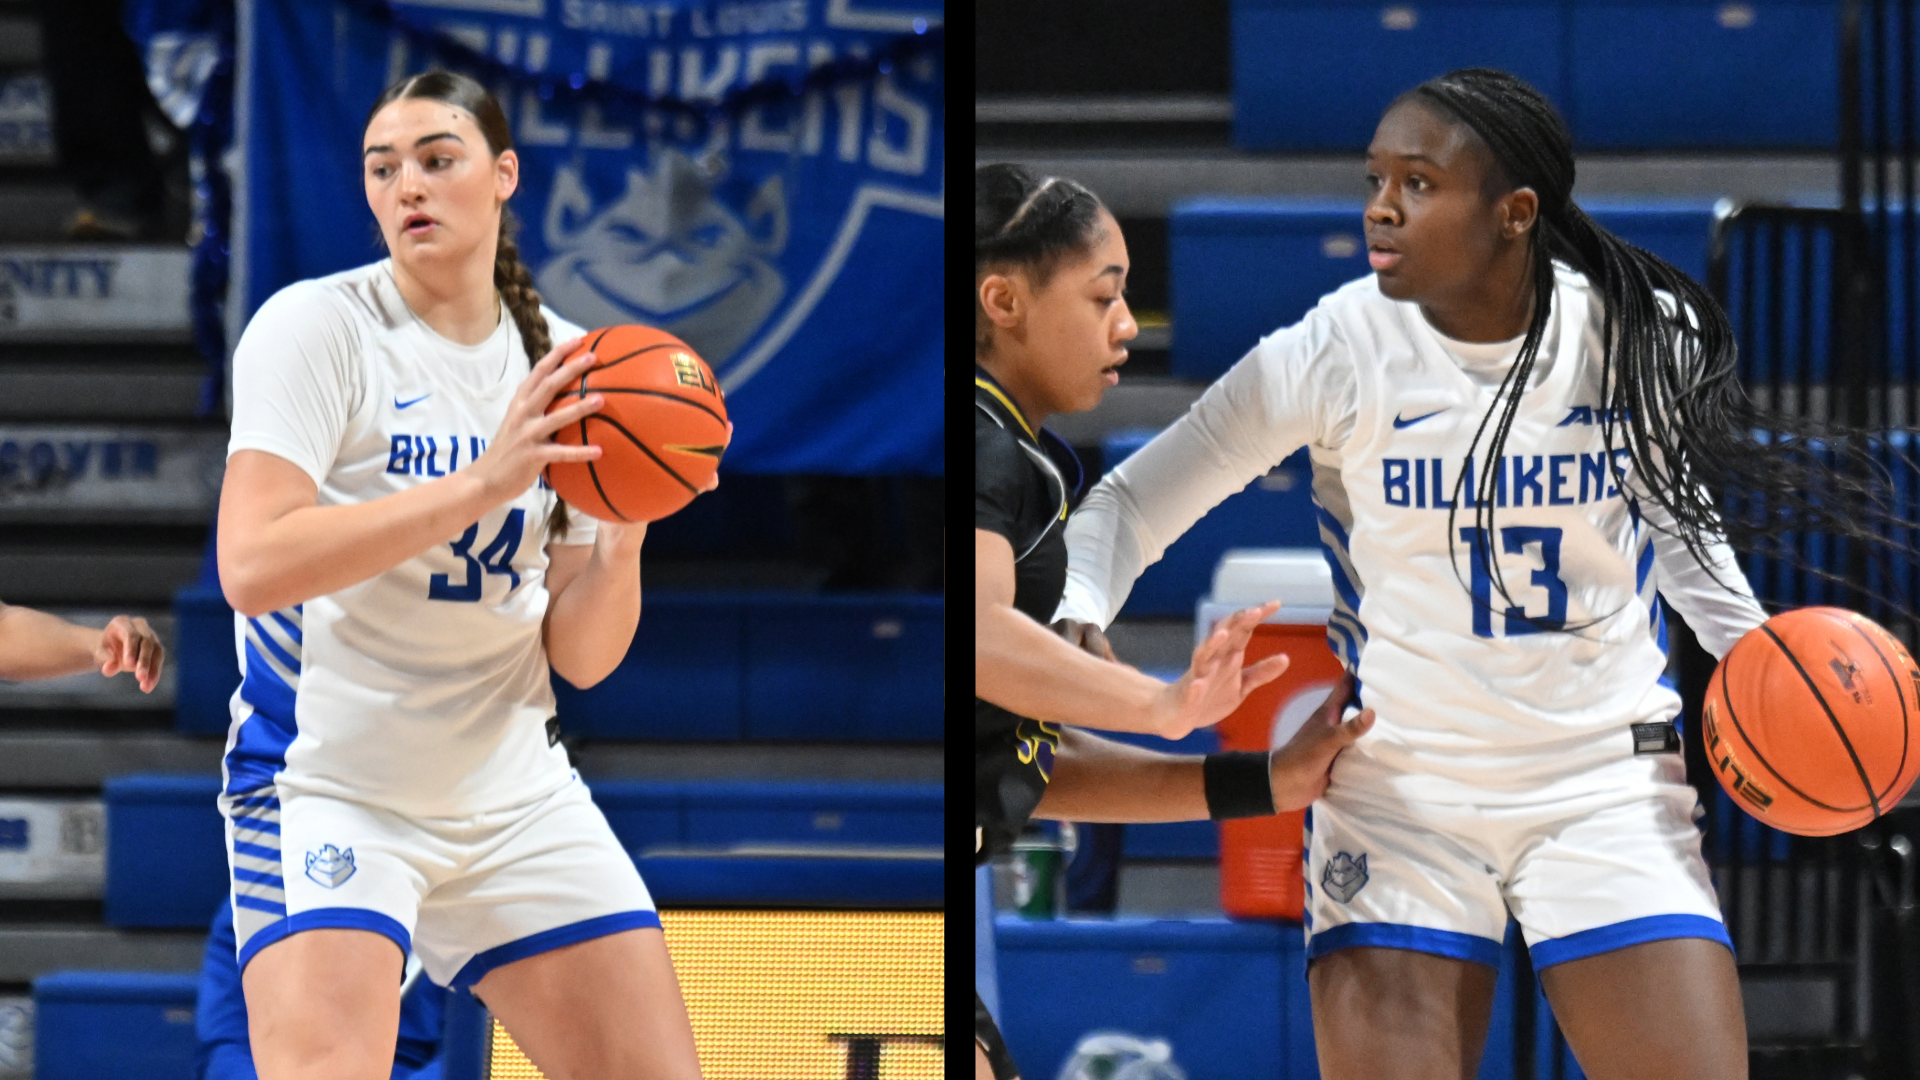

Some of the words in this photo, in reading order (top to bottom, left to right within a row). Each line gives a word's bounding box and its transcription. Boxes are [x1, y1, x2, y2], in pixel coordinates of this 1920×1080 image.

[1381, 448, 1631, 510] BILLIKENS
[427, 508, 526, 603] 34
[1459, 526, 1569, 638] 13
